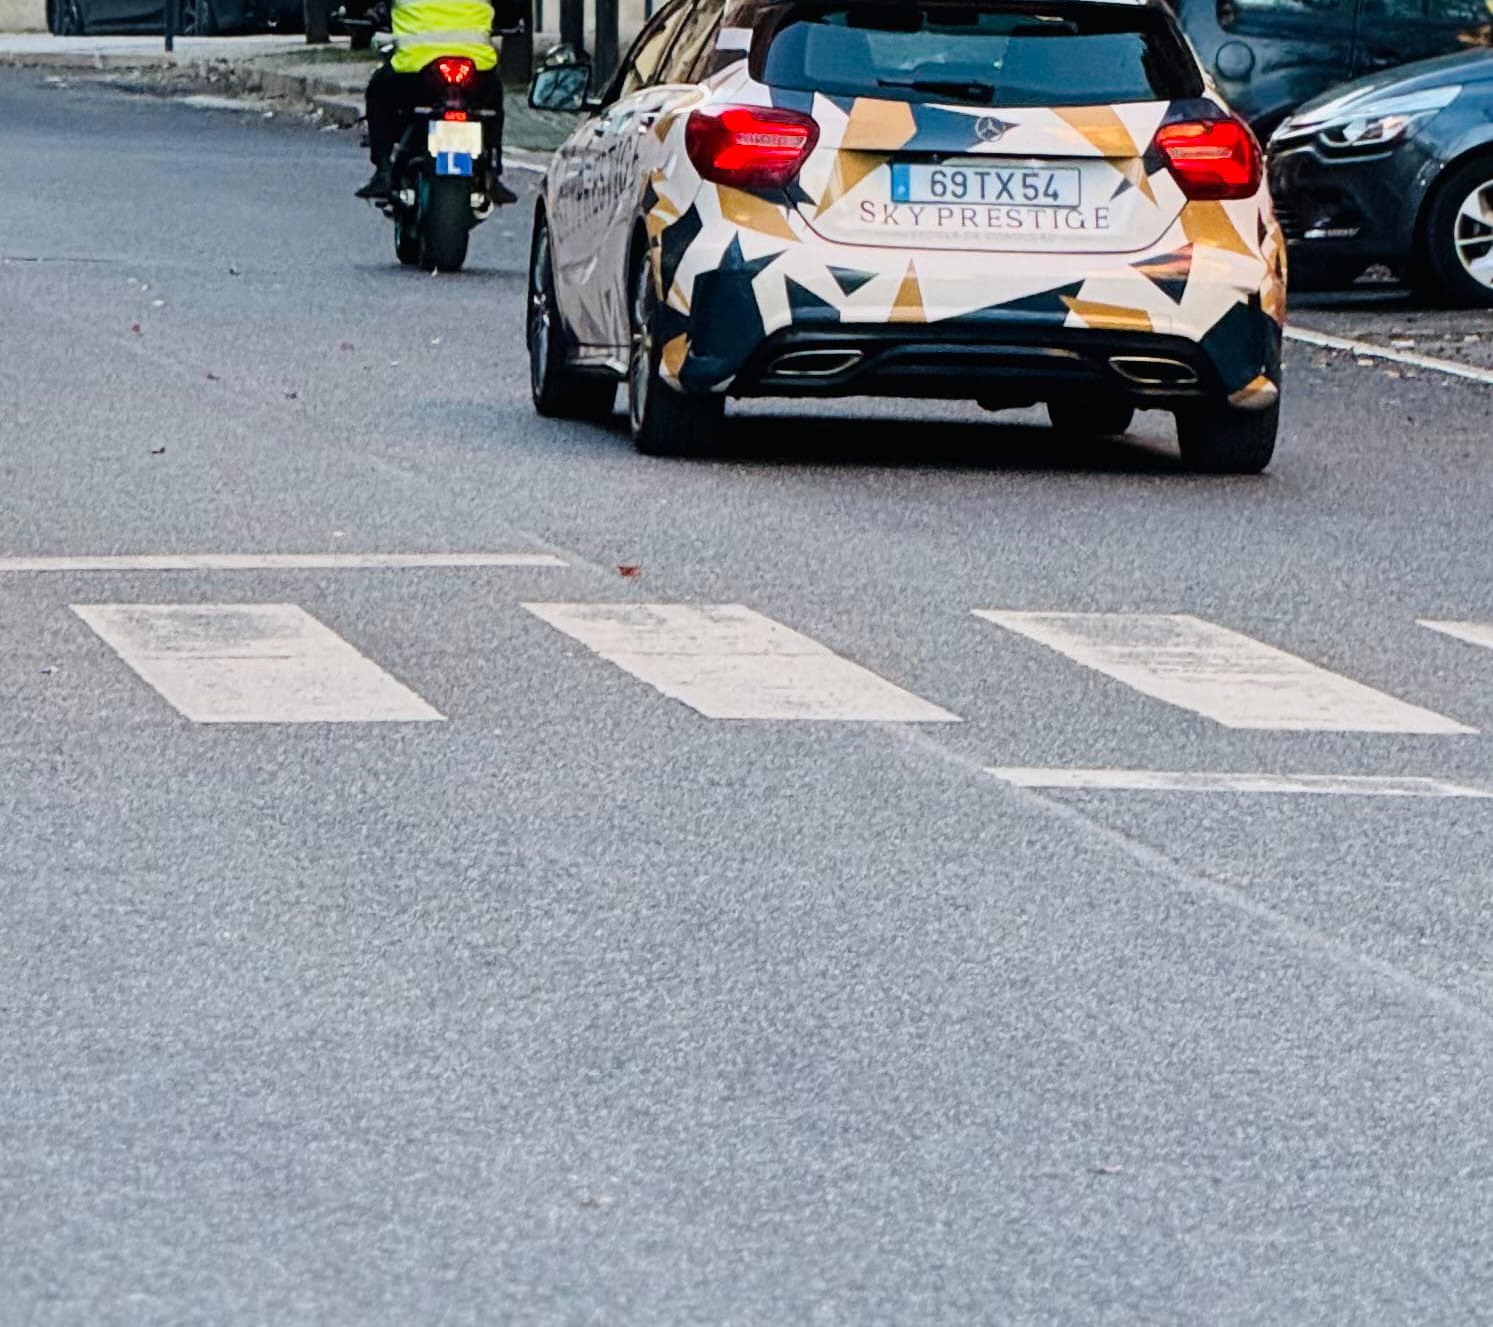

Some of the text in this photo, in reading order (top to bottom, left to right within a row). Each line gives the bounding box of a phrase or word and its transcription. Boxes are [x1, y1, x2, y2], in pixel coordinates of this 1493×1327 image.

[930, 170, 1060, 202] 69TX54
[860, 200, 1111, 230] SKY PRESTIGE
